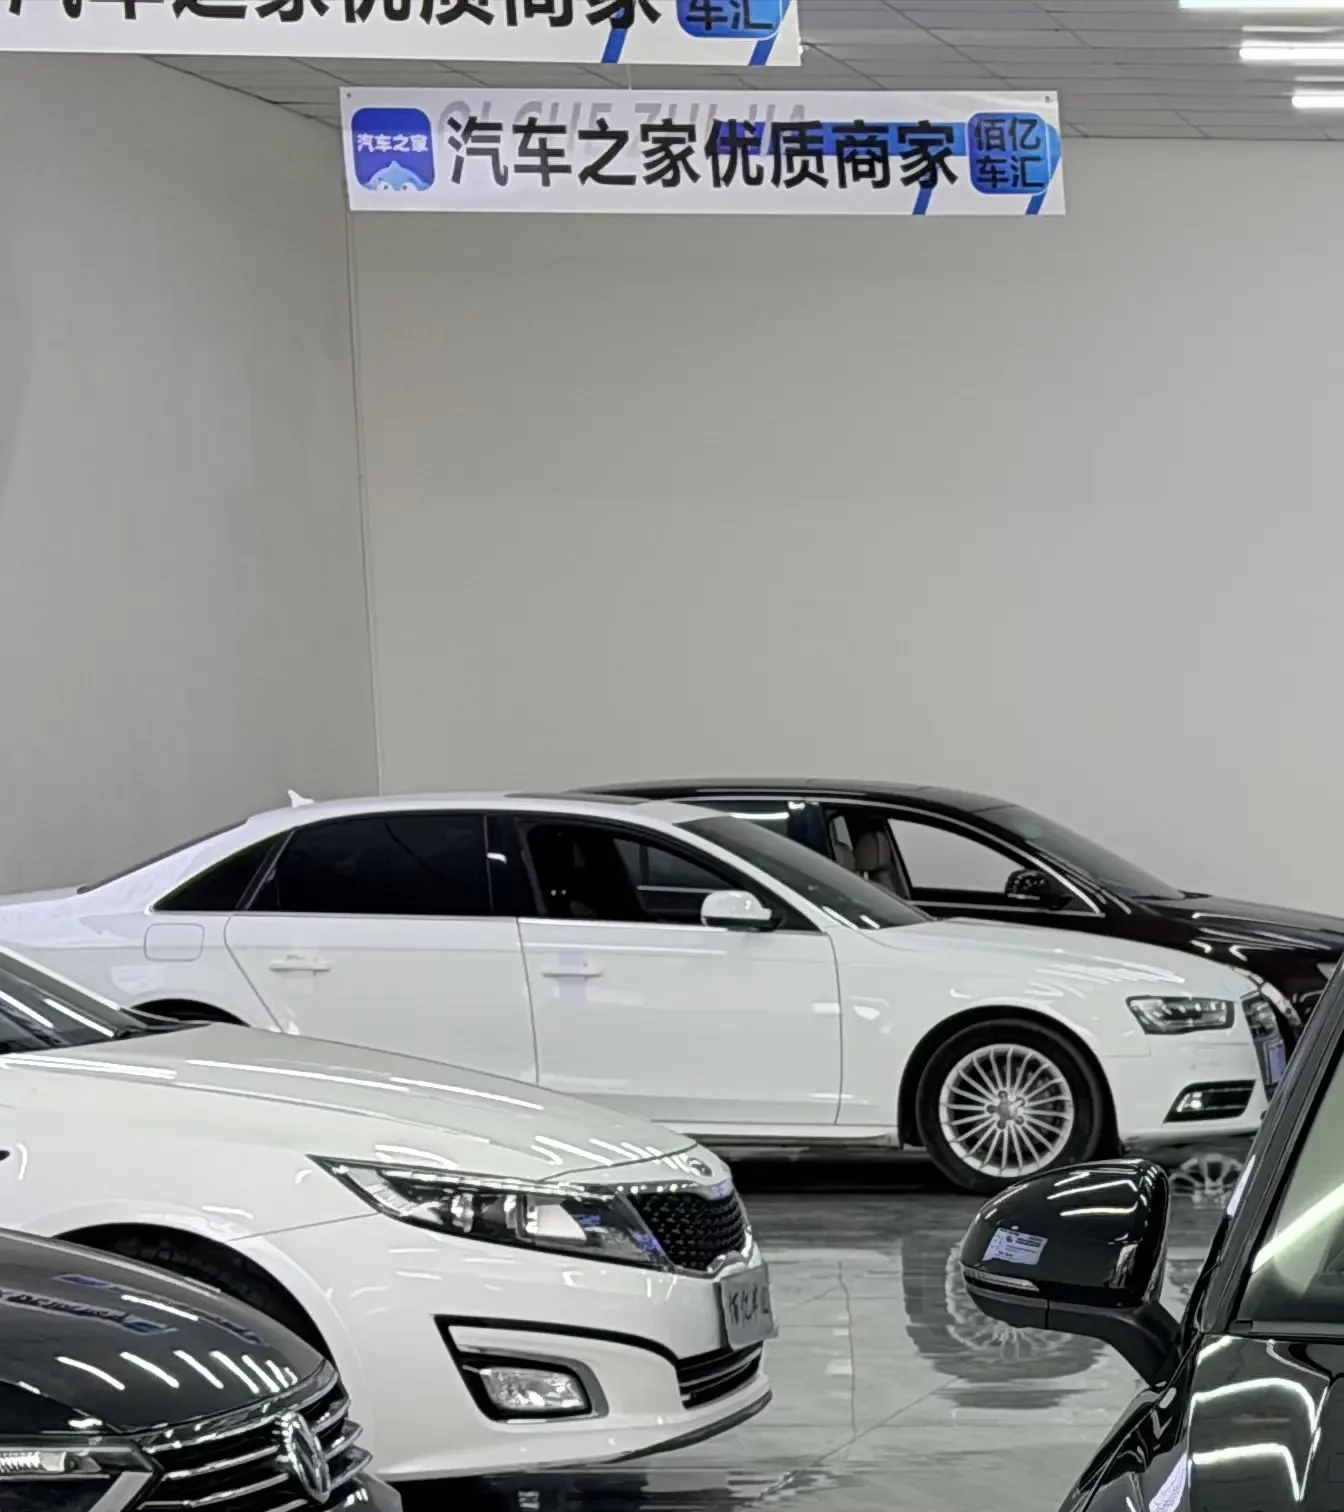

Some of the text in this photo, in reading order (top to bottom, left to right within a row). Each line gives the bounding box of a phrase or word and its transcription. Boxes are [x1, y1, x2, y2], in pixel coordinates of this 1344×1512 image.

[356, 132, 430, 153] 汽车之家
[975, 117, 1043, 152] 佰亿
[446, 116, 958, 189] 汽车之家优质商家
[976, 155, 1045, 189] 车汇
